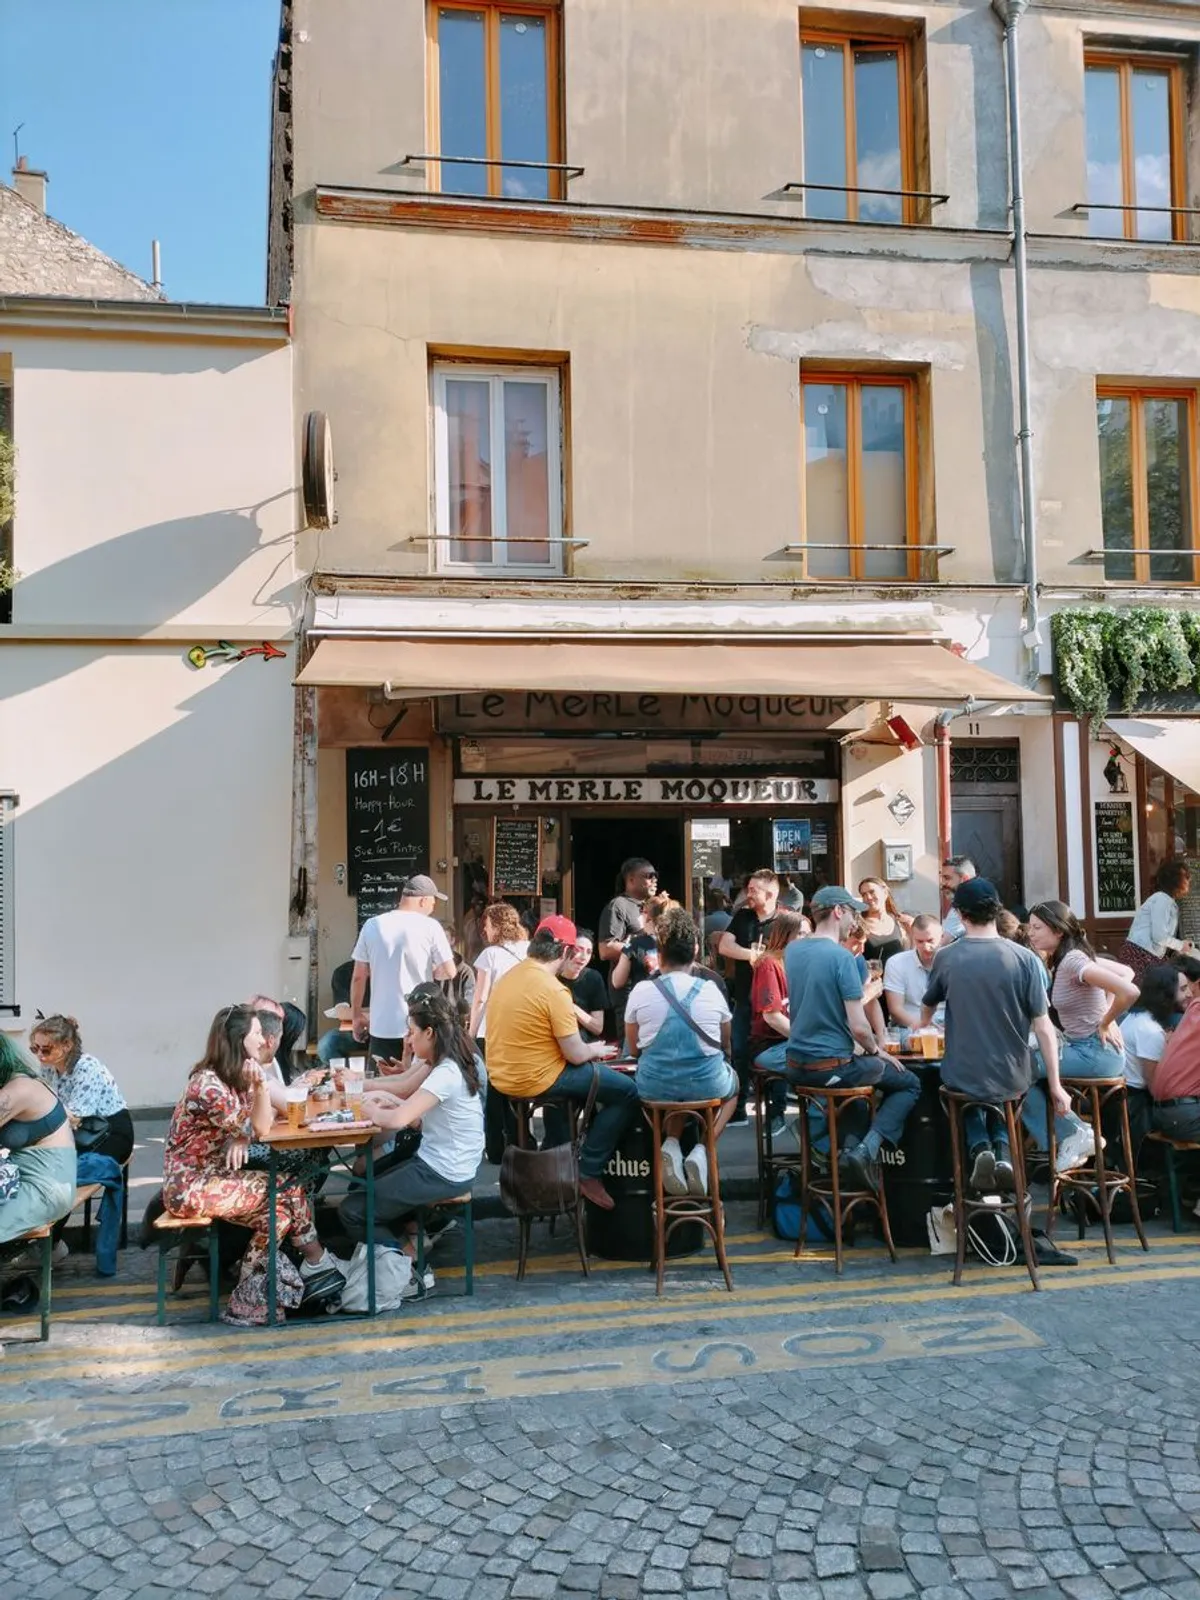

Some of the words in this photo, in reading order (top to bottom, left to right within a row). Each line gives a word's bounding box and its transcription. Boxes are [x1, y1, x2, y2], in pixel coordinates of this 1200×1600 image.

[968, 722, 981, 736] 11
[473, 780, 517, 802] LE
[528, 780, 643, 802] MERLE
[660, 779, 819, 803] MOQUEUR
[775, 830, 801, 842] OPEN
[775, 841, 794, 853] MIC
[603, 1149, 651, 1177] chus
